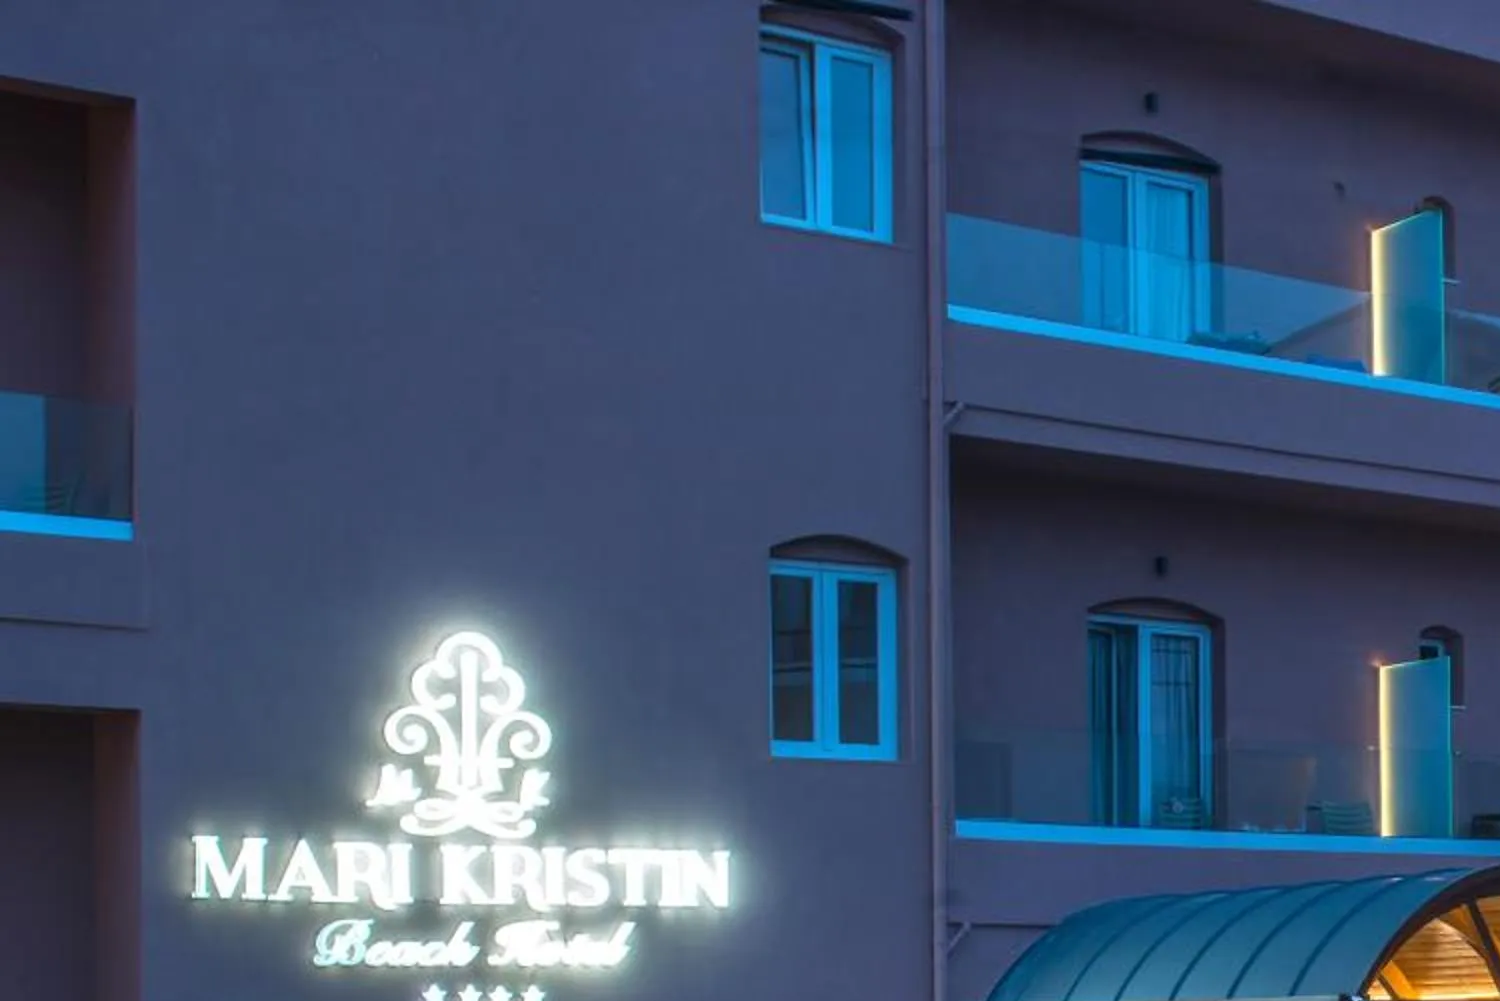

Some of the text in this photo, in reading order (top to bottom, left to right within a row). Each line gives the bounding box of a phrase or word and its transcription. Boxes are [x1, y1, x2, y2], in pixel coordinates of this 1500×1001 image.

[191, 835, 731, 911] MARI KRISTIN
[313, 918, 638, 967] Beach Hotel
